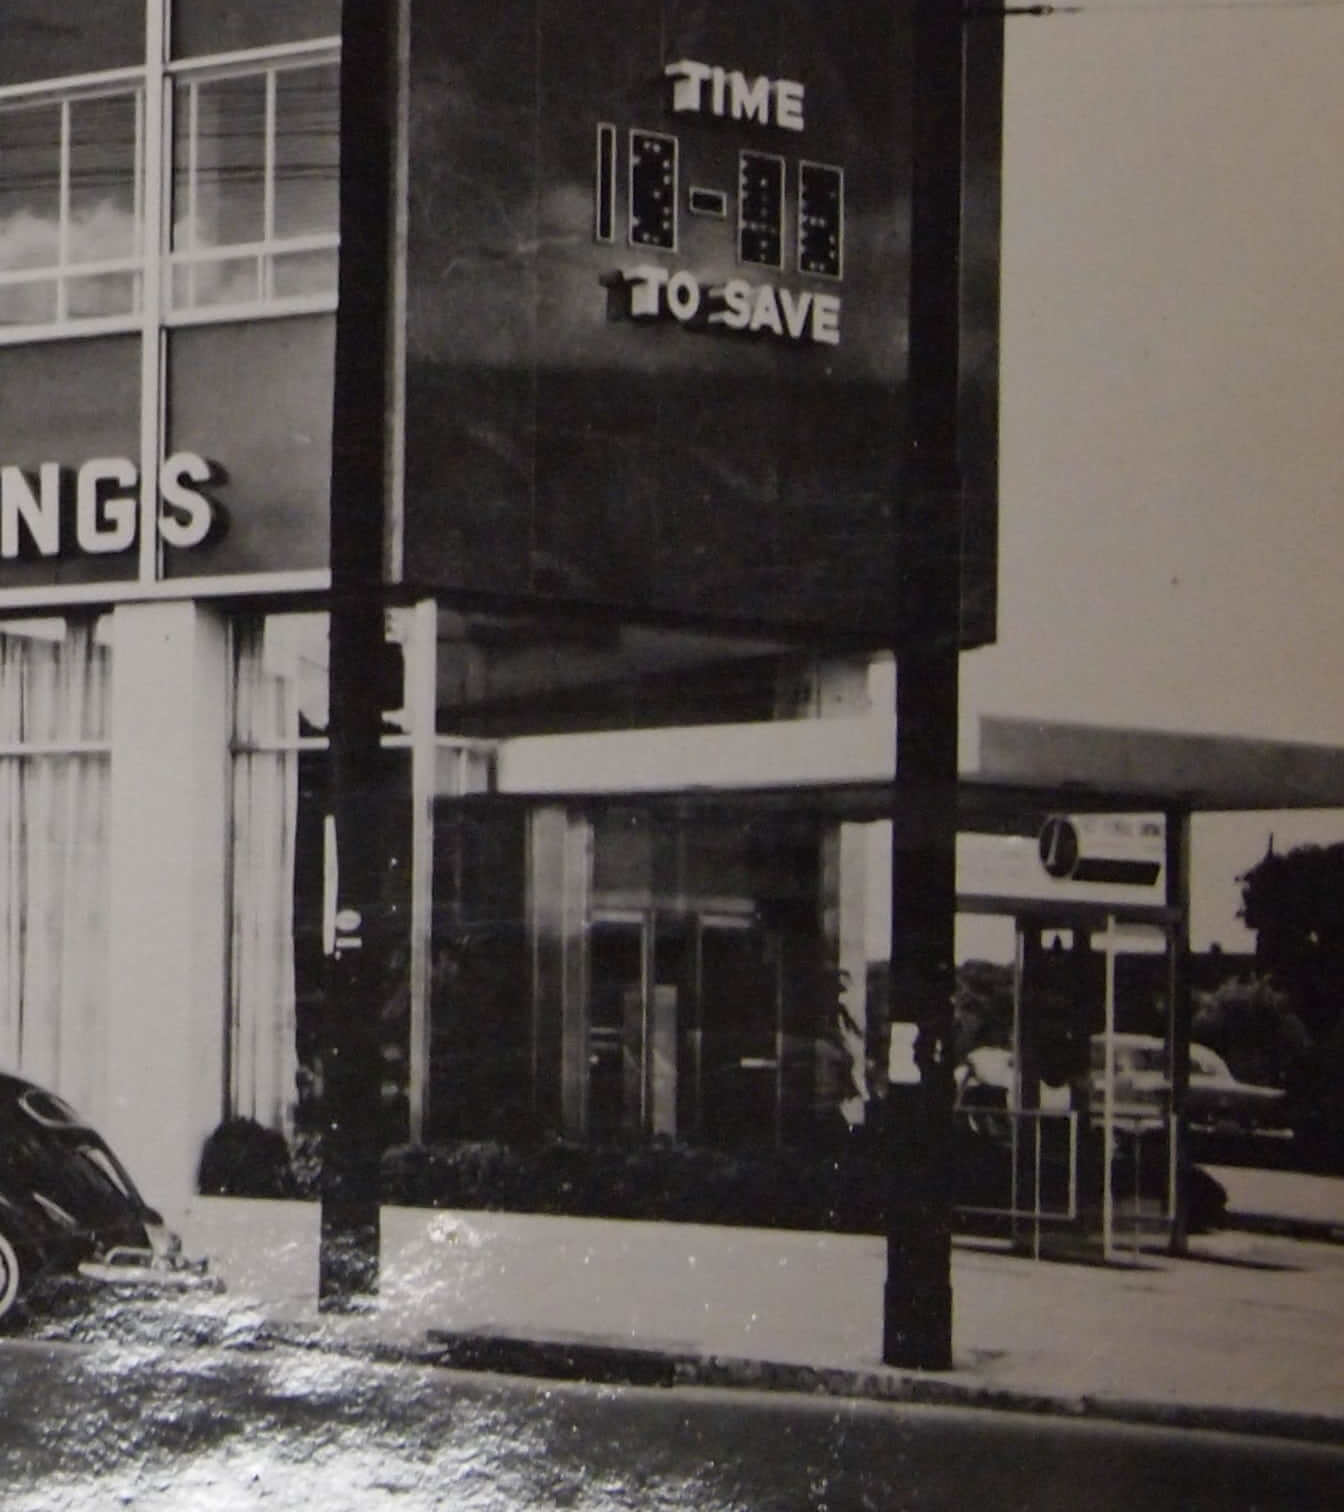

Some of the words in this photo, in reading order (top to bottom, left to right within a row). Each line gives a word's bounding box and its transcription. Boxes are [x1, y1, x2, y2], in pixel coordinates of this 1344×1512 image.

[664, 59, 806, 133] TIME
[620, 262, 701, 322] TO
[710, 278, 842, 347] SAVE
